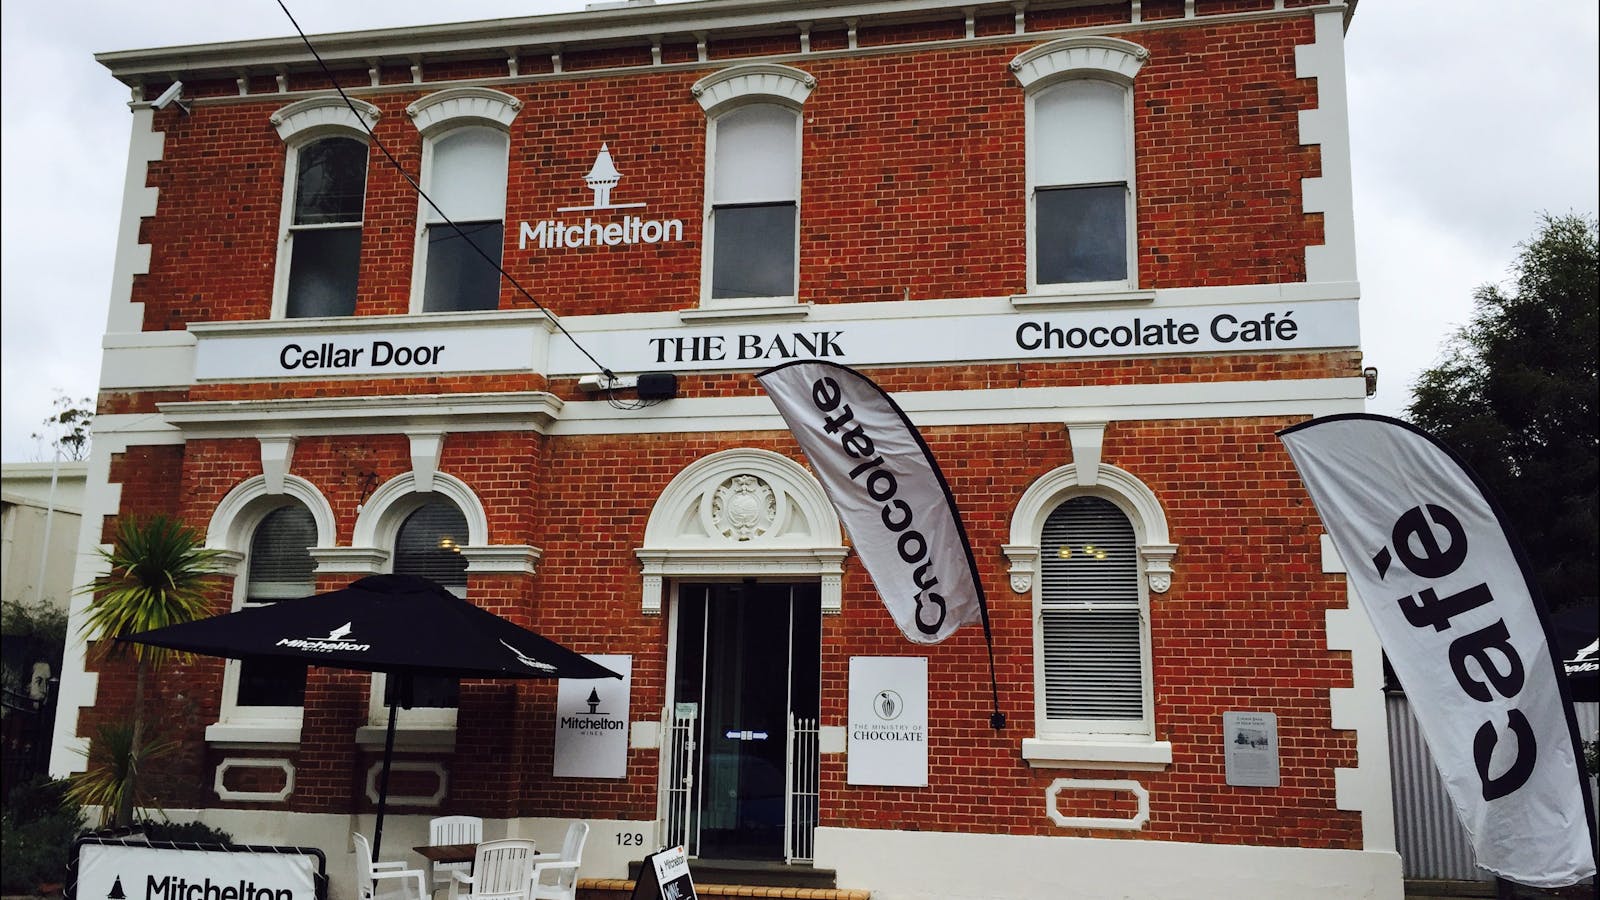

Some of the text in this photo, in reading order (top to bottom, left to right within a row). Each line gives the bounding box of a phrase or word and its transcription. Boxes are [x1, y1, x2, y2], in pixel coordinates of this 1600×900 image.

[519, 216, 683, 250] Mitchelton
[1015, 310, 1298, 351] Chocolate Café
[279, 341, 445, 370] Cellar Door
[649, 331, 845, 363] THE BANK
[812, 375, 947, 635] Chocolate
[276, 638, 371, 652] Mitchelton
[560, 716, 624, 730] Mitchelton
[853, 731, 922, 742] CHOCOLATE
[615, 833, 643, 846] 129
[146, 874, 293, 900] Mitchelton
